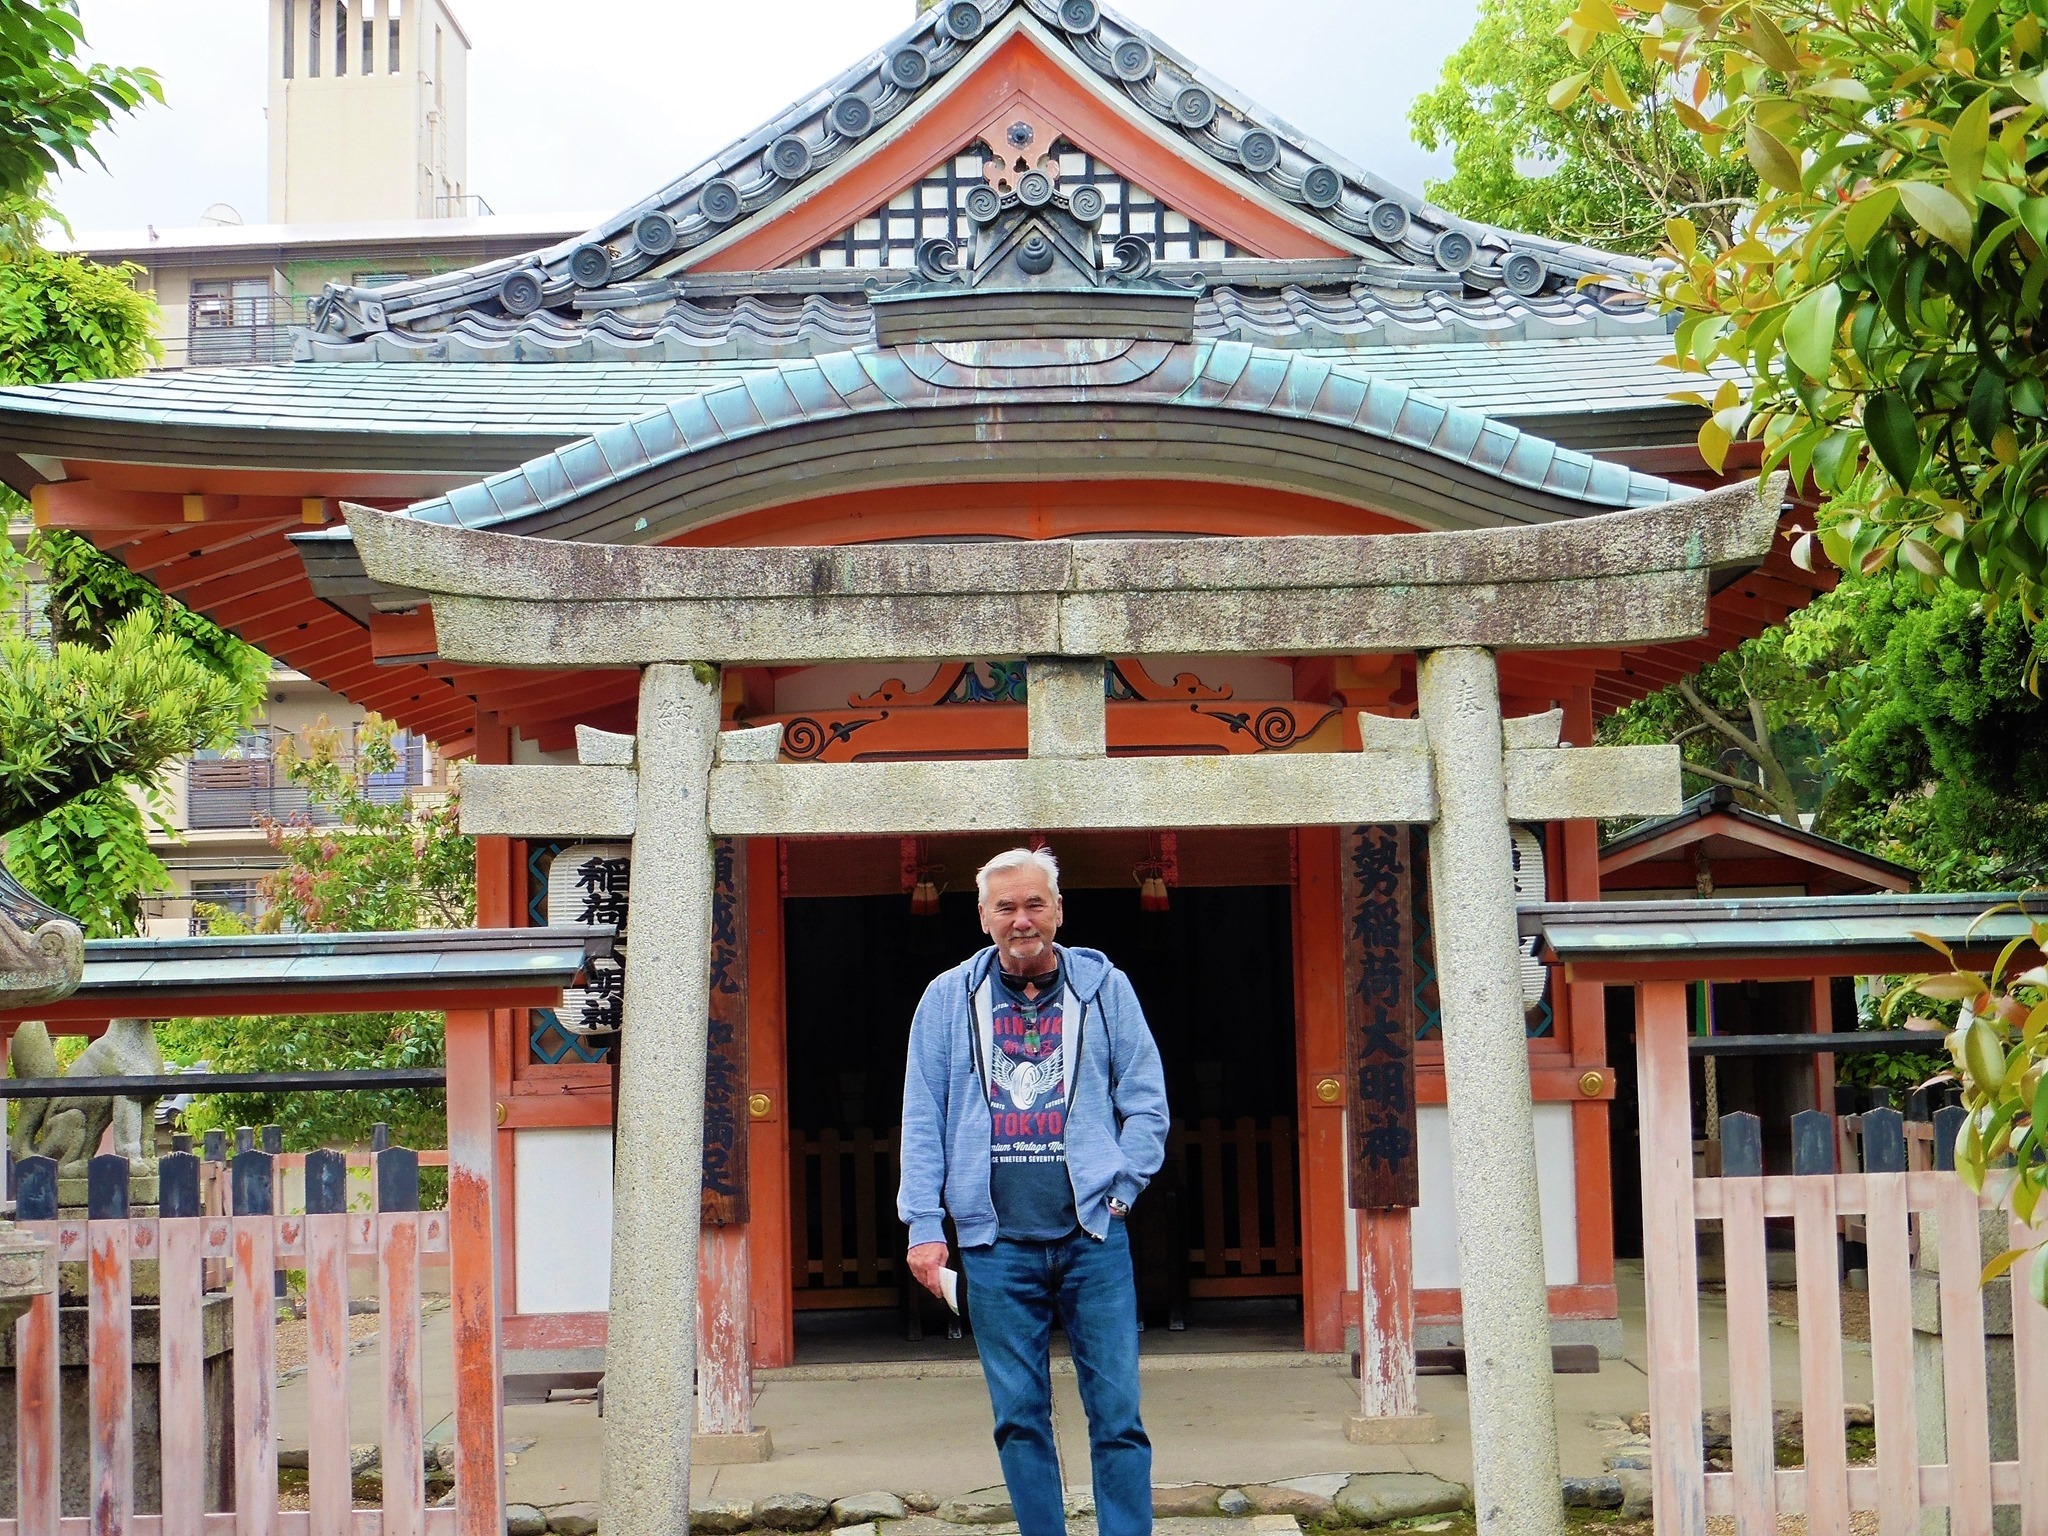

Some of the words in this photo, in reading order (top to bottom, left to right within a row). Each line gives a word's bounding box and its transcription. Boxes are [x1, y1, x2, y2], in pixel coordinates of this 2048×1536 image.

[1351, 824, 1410, 1175] 勢稲荷大明神
[992, 1111, 1063, 1137] TOKYO
[1012, 1141, 1047, 1154] Vintage
[999, 1155, 1027, 1163] NINETEEN
[1028, 1155, 1055, 1163] SEVENTY
